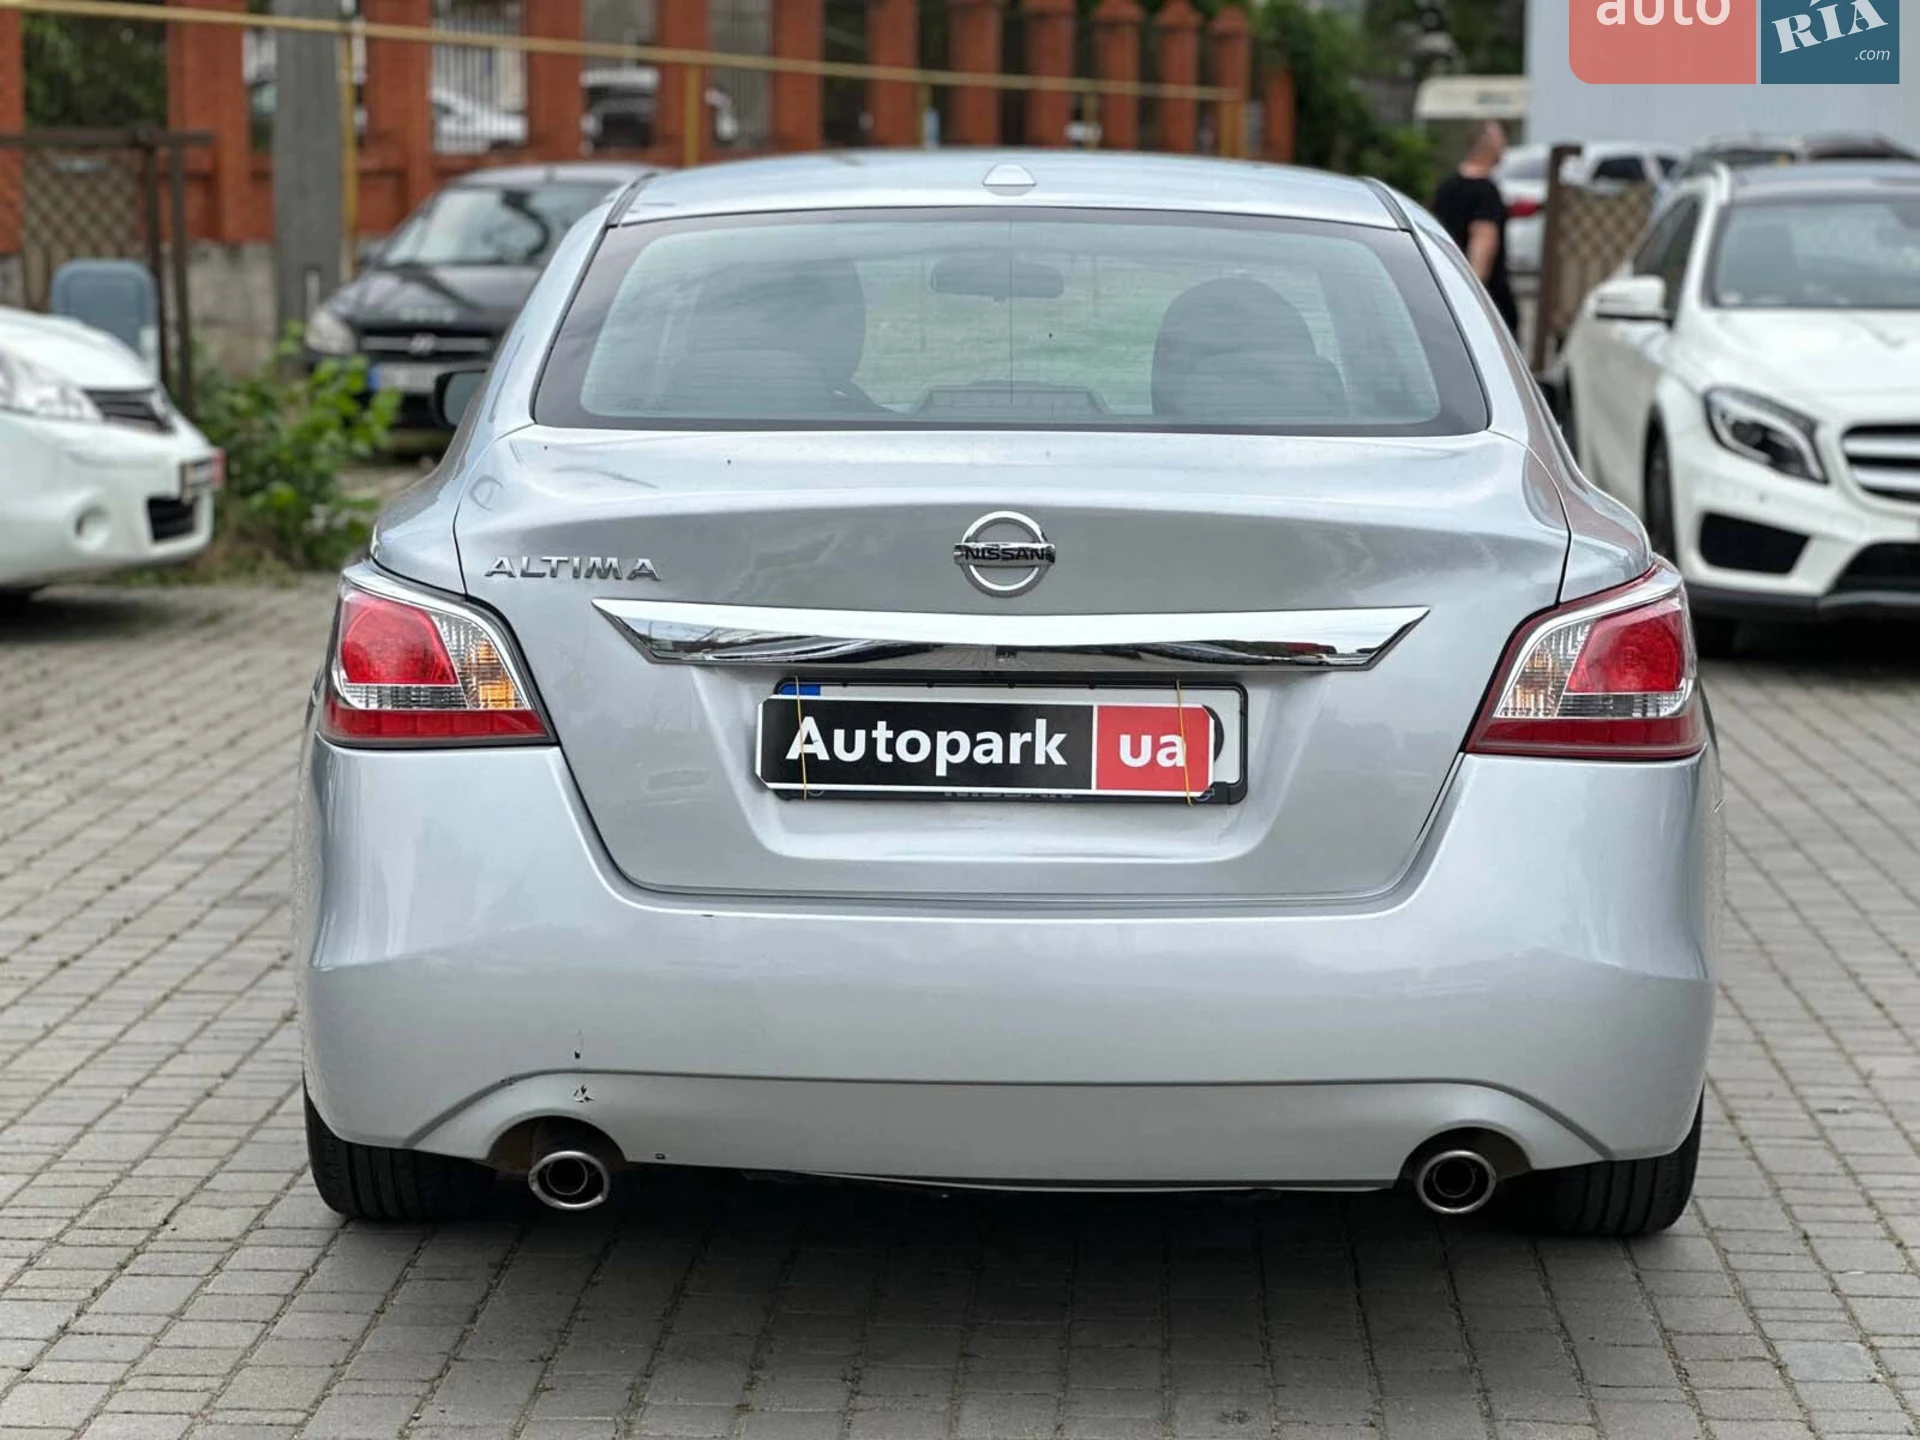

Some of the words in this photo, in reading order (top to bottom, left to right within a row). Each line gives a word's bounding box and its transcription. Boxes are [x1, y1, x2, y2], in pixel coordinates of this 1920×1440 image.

[964, 547, 1045, 561] NISSAN
[484, 556, 662, 581] ALTIMA
[786, 716, 1067, 776] Autopark
[1119, 733, 1187, 767] ua
